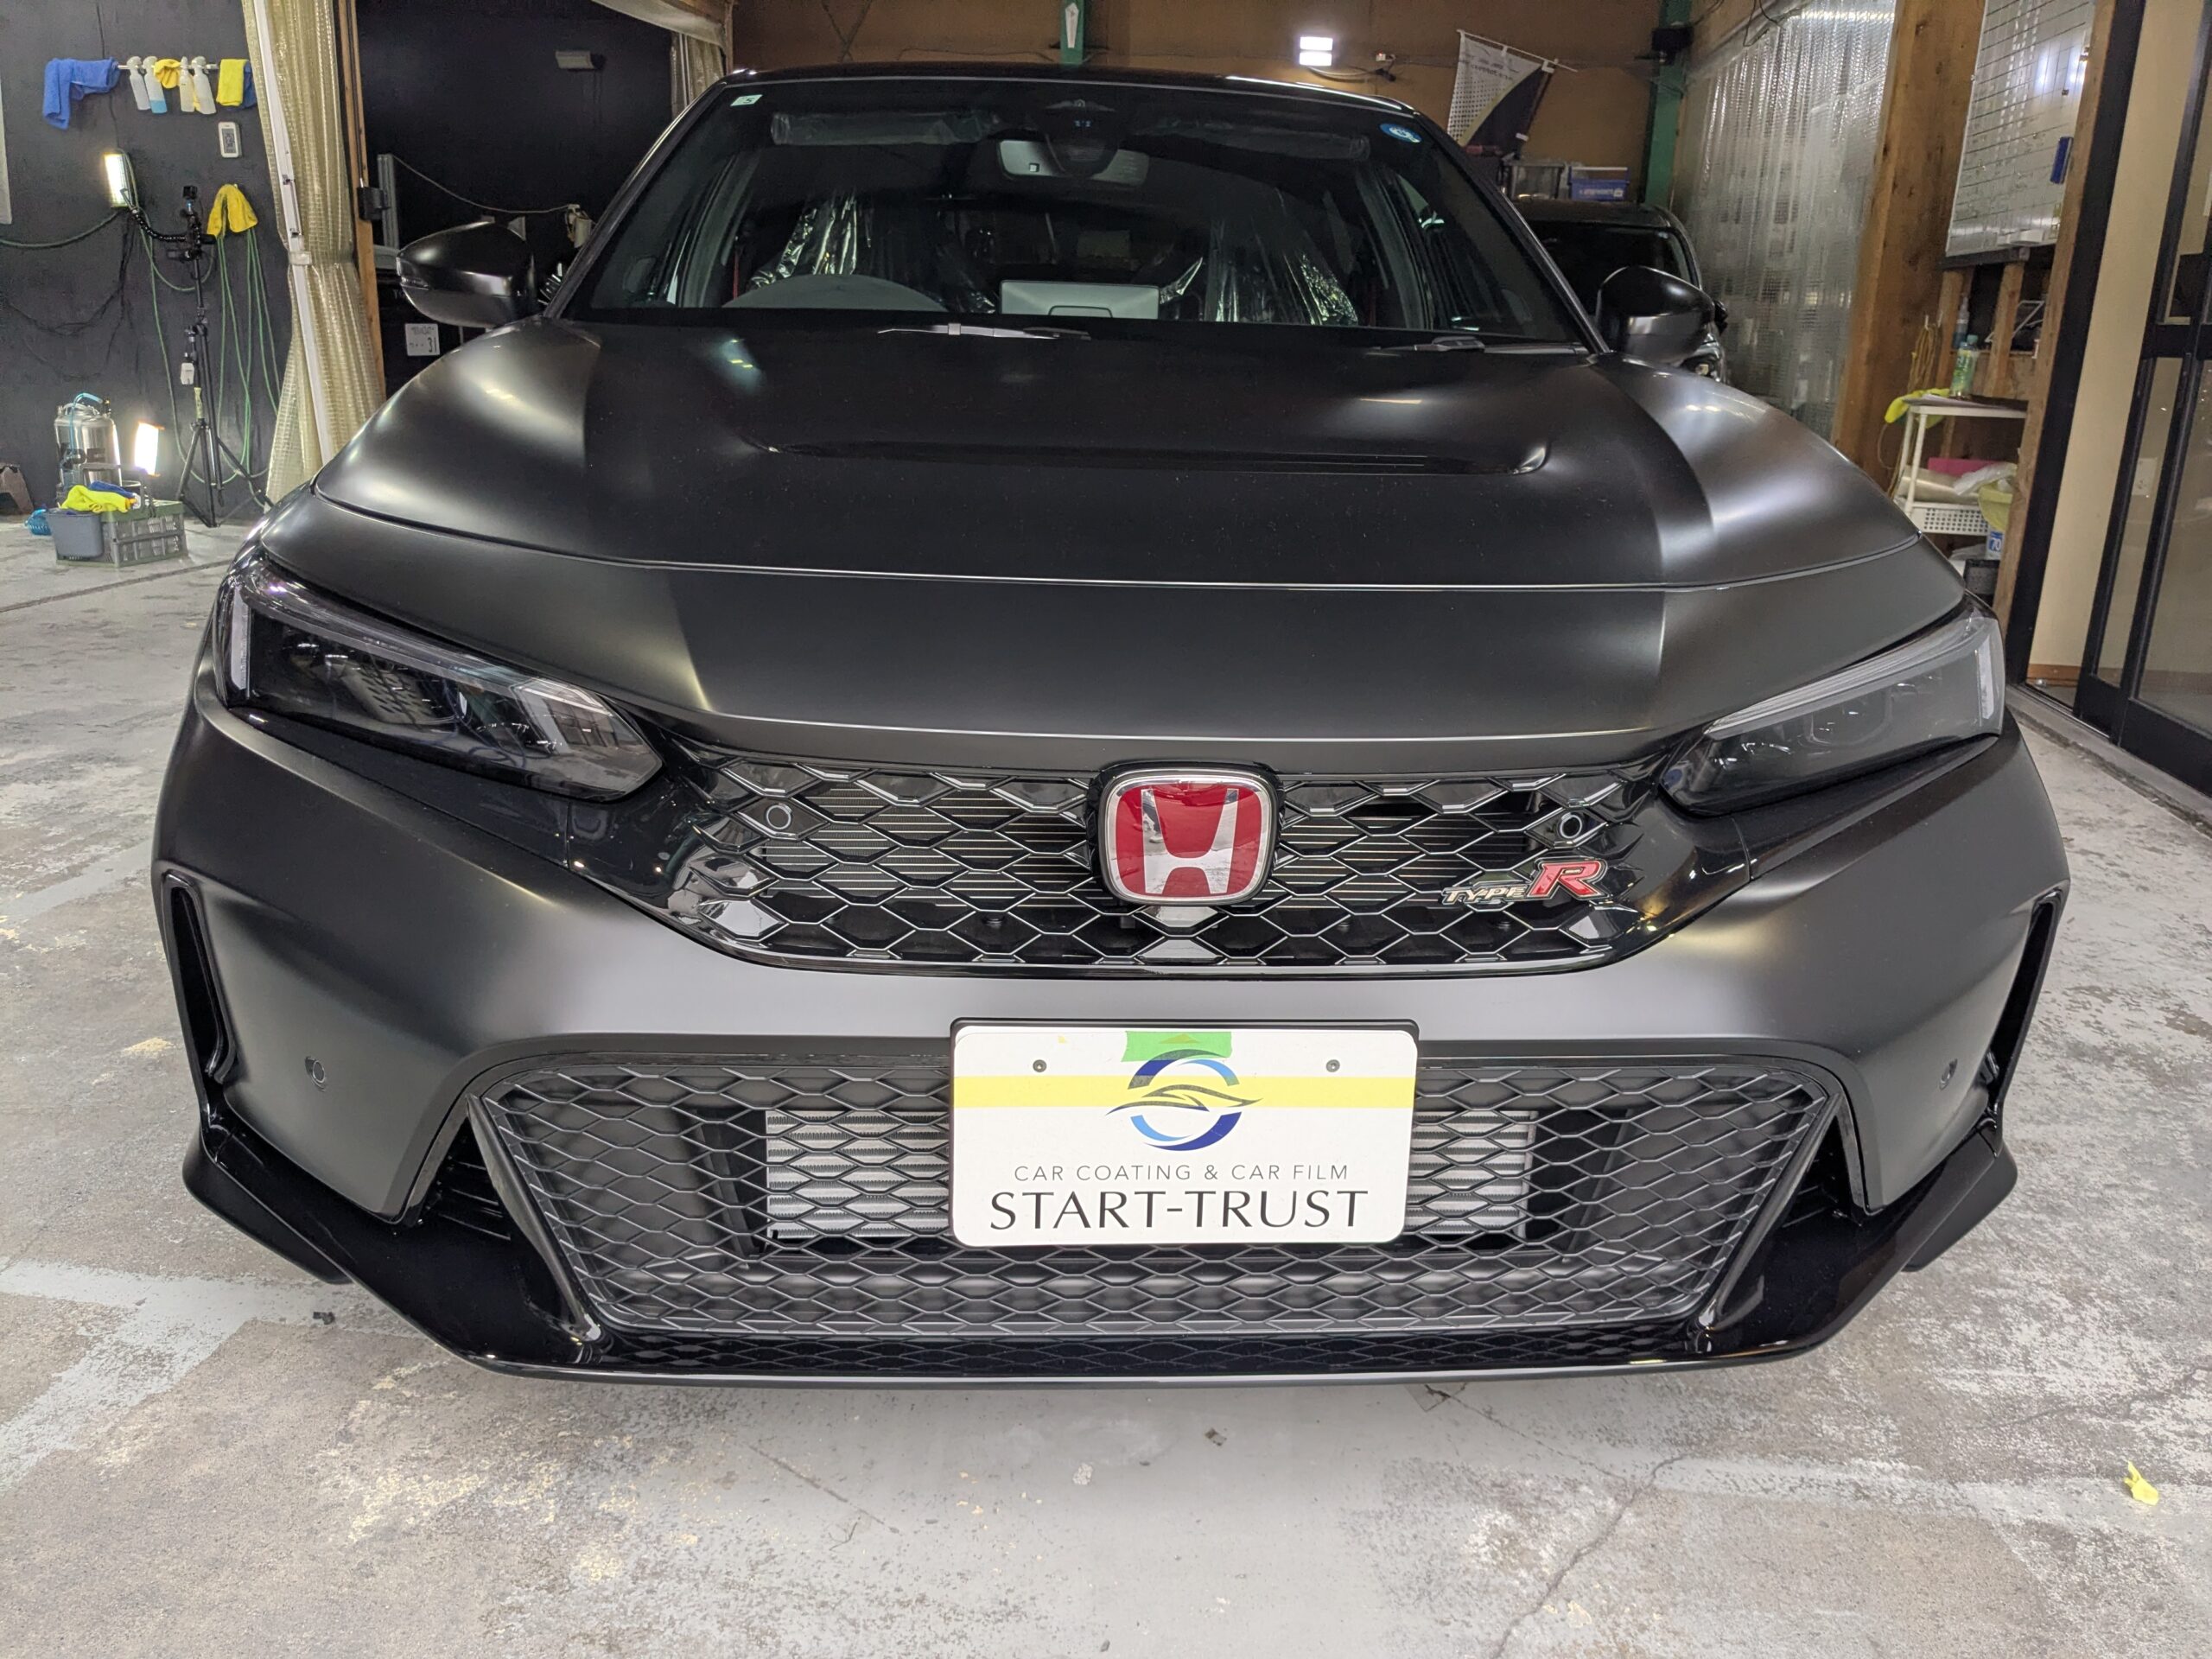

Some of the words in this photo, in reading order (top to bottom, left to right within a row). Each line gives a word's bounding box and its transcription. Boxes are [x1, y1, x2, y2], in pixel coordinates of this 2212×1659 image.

[1443, 885, 1528, 904] TYPE
[1526, 859, 1606, 899] R
[1014, 1164, 1064, 1182] CAR
[1075, 1164, 1192, 1181] COATING
[1203, 1164, 1219, 1181] &
[1230, 1164, 1281, 1181] CAR
[1292, 1164, 1349, 1180] FILM
[990, 1190, 1369, 1230] START-TRUST
